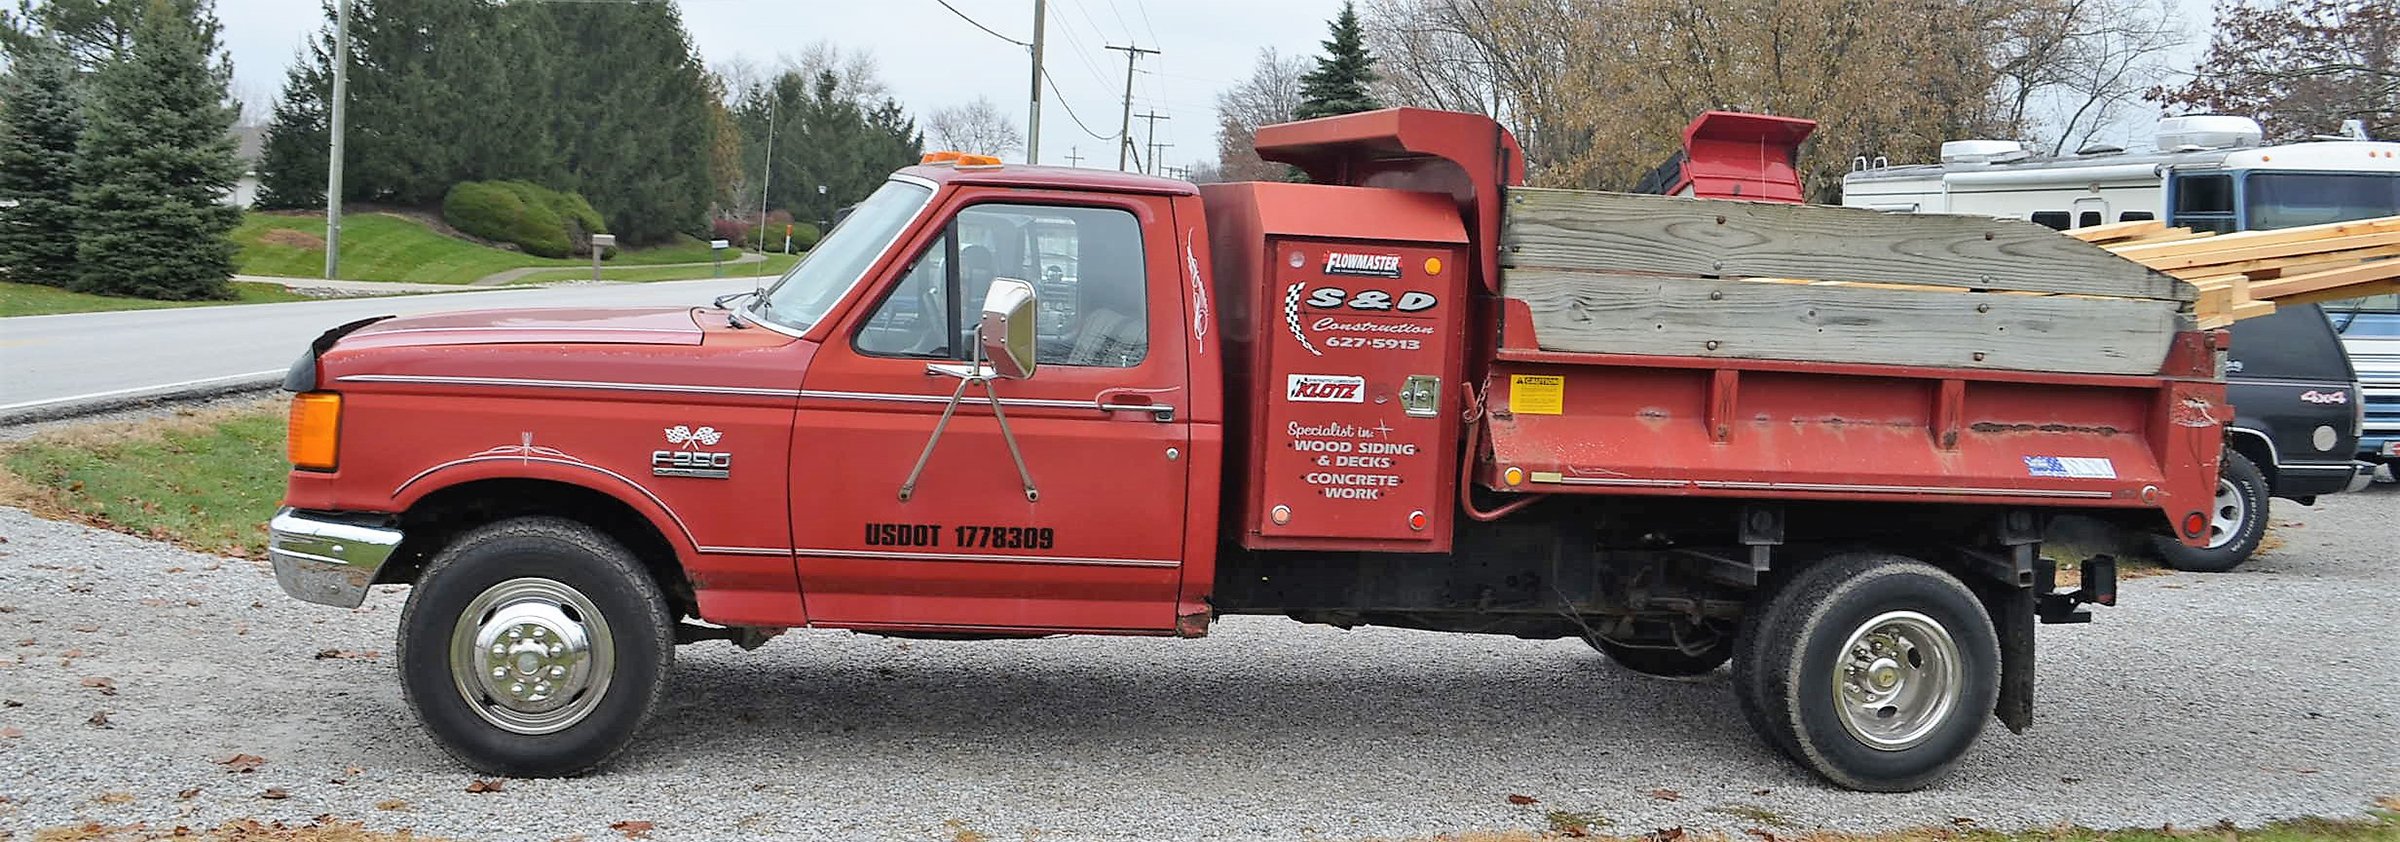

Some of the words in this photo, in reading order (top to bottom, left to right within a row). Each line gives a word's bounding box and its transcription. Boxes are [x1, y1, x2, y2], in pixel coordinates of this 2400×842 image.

[1325, 252, 1399, 273] FLOWMASTER
[1311, 317, 1435, 335] Construction
[1294, 383, 1361, 399] KLOTZ
[1287, 421, 1355, 438] Specialist
[1293, 439, 1353, 453] WOOD
[1358, 442, 1416, 455] SIDING
[1317, 455, 1331, 467] &
[1335, 456, 1391, 469] DECKS
[1306, 472, 1400, 487] CONCRETE
[1324, 487, 1379, 500] WORK
[865, 523, 942, 547] USDOT
[955, 525, 1055, 550] 1778309
